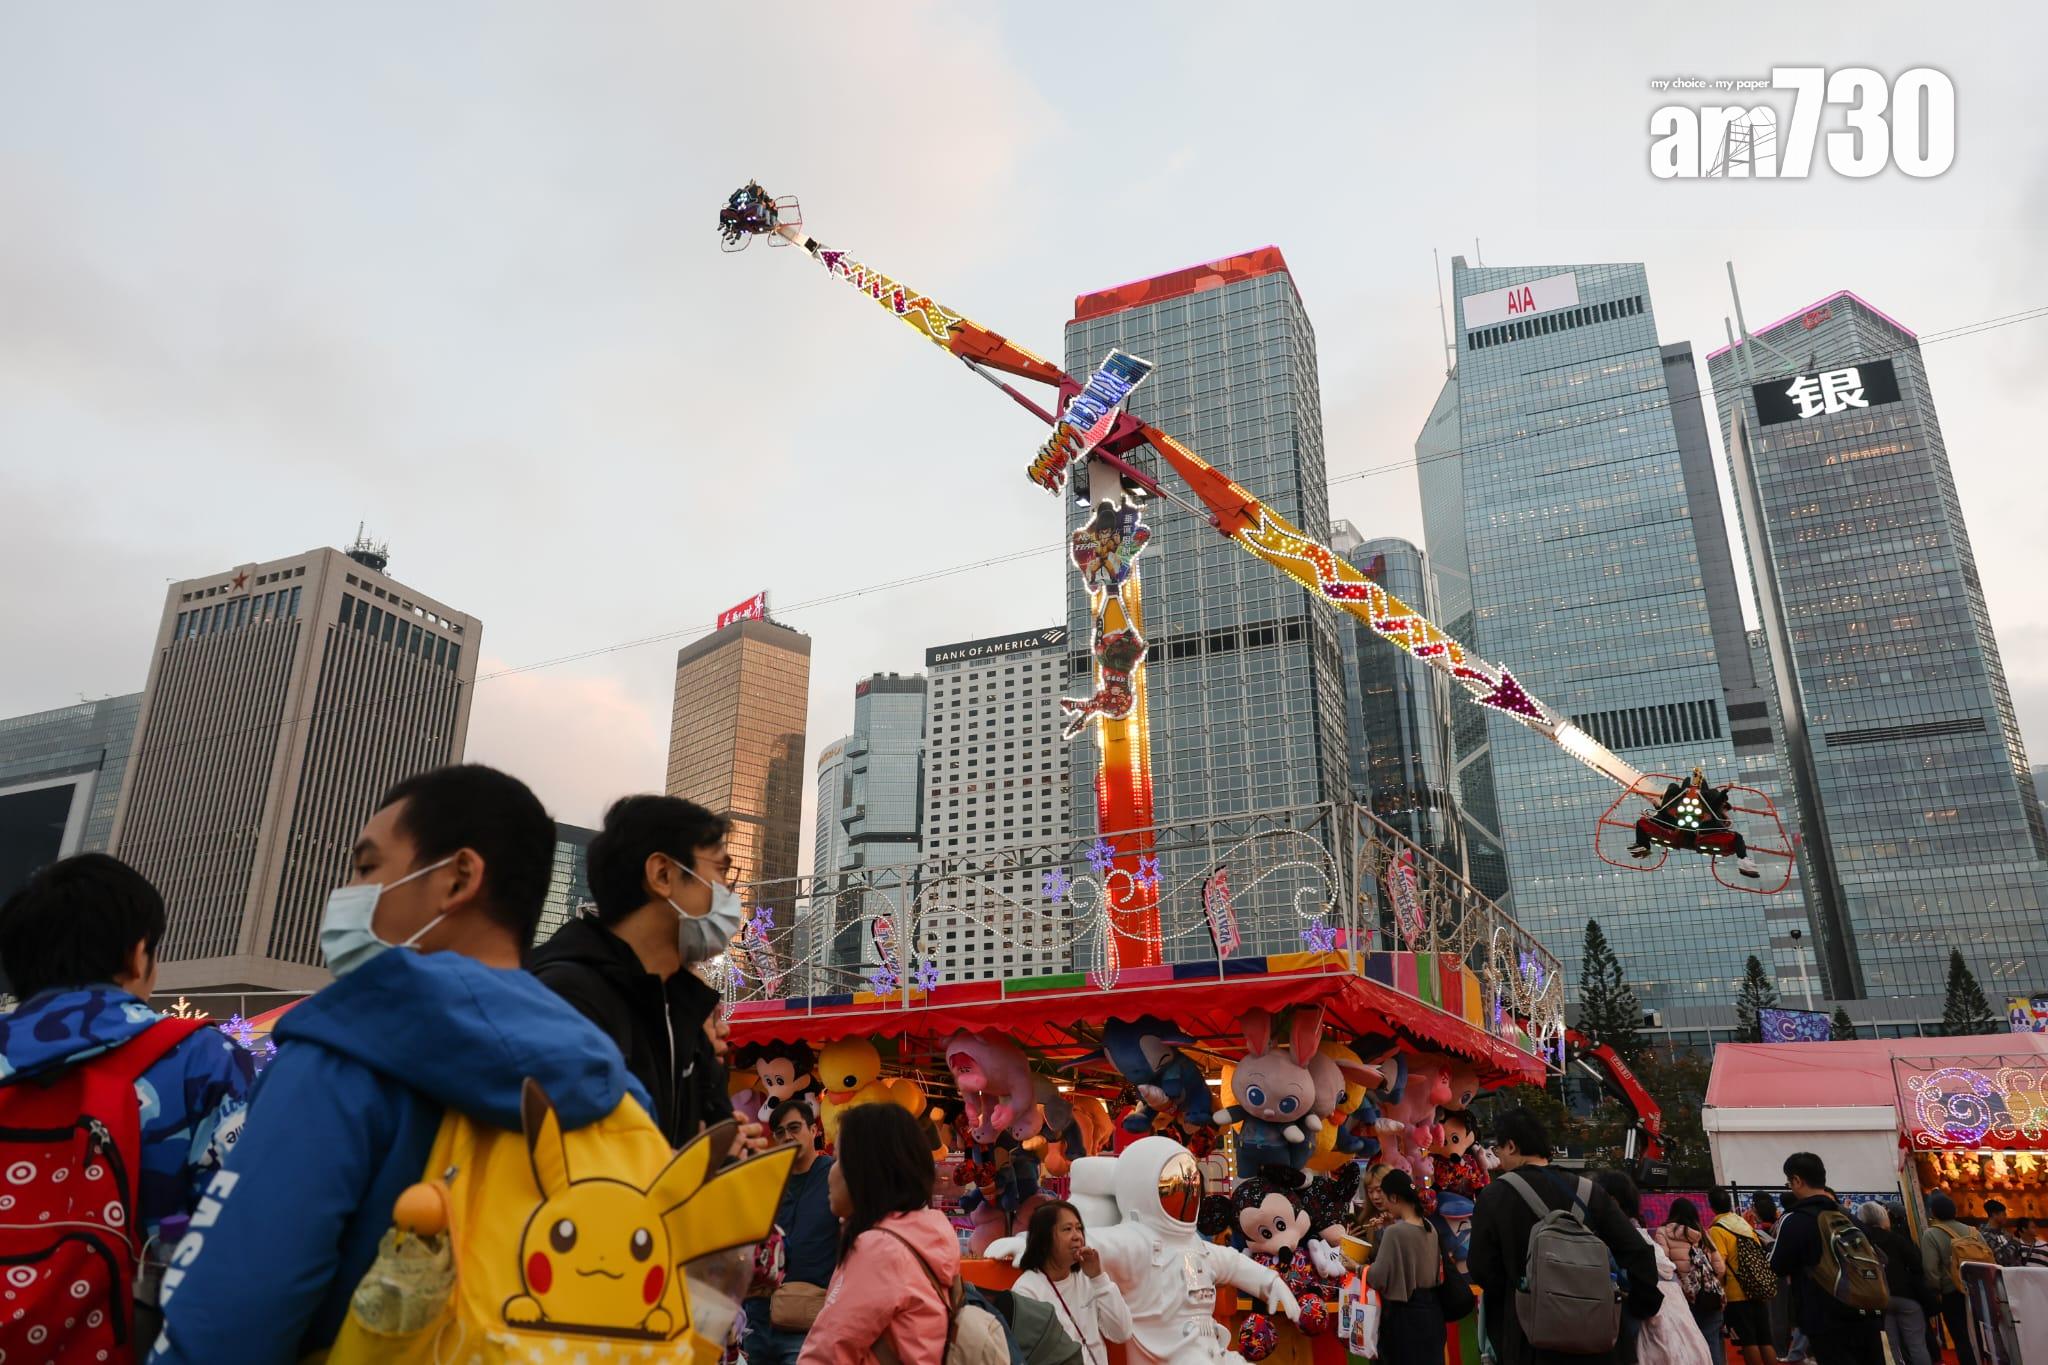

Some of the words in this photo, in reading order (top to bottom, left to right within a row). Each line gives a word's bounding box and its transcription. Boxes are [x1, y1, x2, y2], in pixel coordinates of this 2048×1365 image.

[1508, 286, 1536, 315] AIA
[1785, 367, 1869, 419] 银
[935, 649, 966, 662] BANK
[968, 646, 983, 656] OF
[986, 638, 1039, 653] AMERICA
